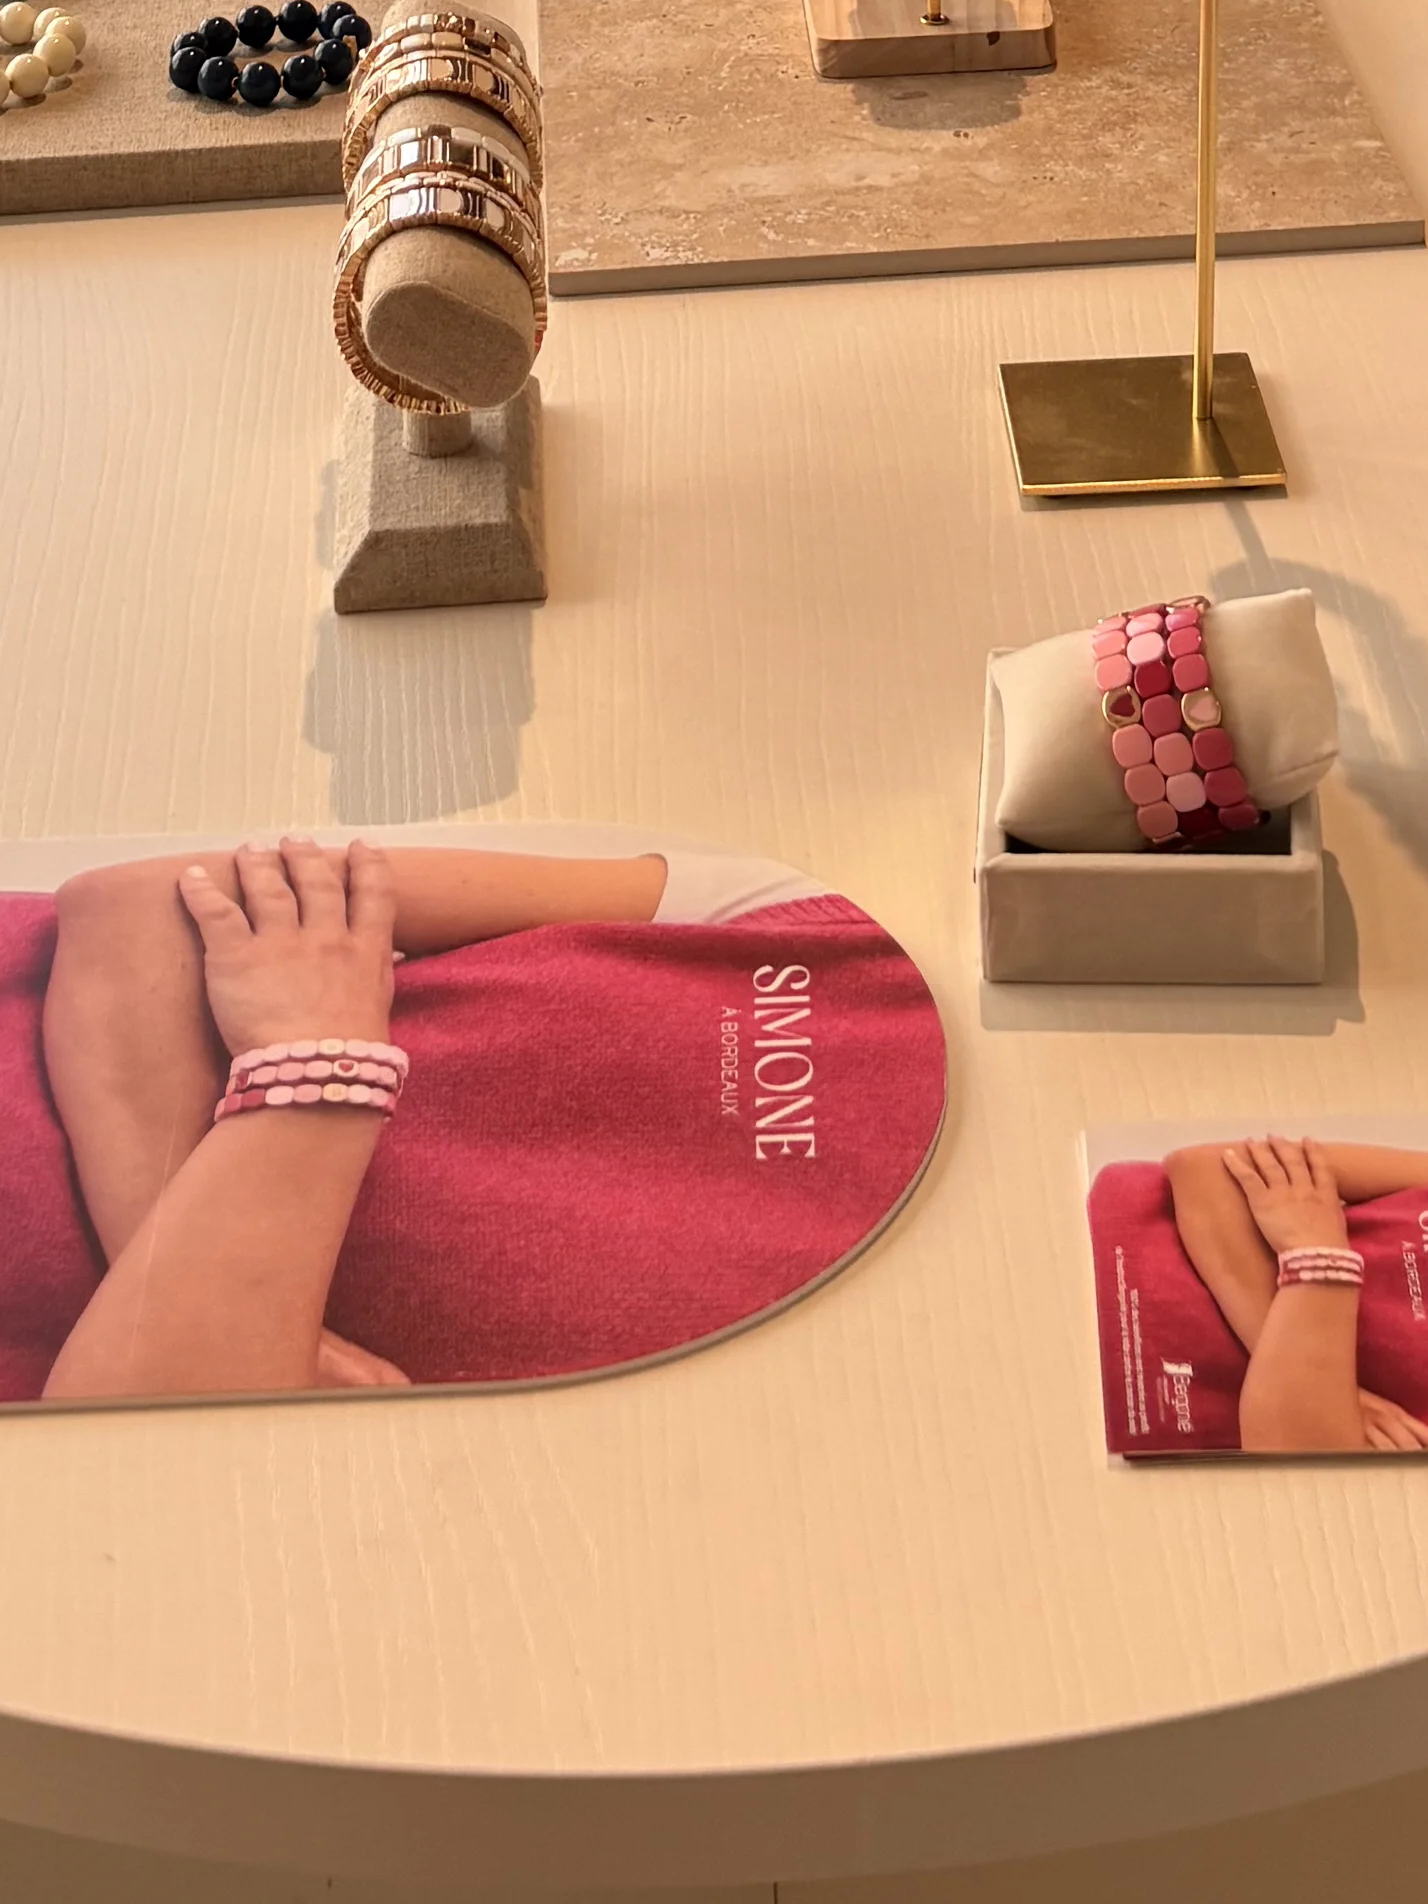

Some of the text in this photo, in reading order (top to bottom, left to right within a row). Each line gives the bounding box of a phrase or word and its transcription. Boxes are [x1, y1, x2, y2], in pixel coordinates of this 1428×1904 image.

[720, 1005, 741, 1116] À BORDEAUX
[753, 964, 815, 1160] SIMONE
